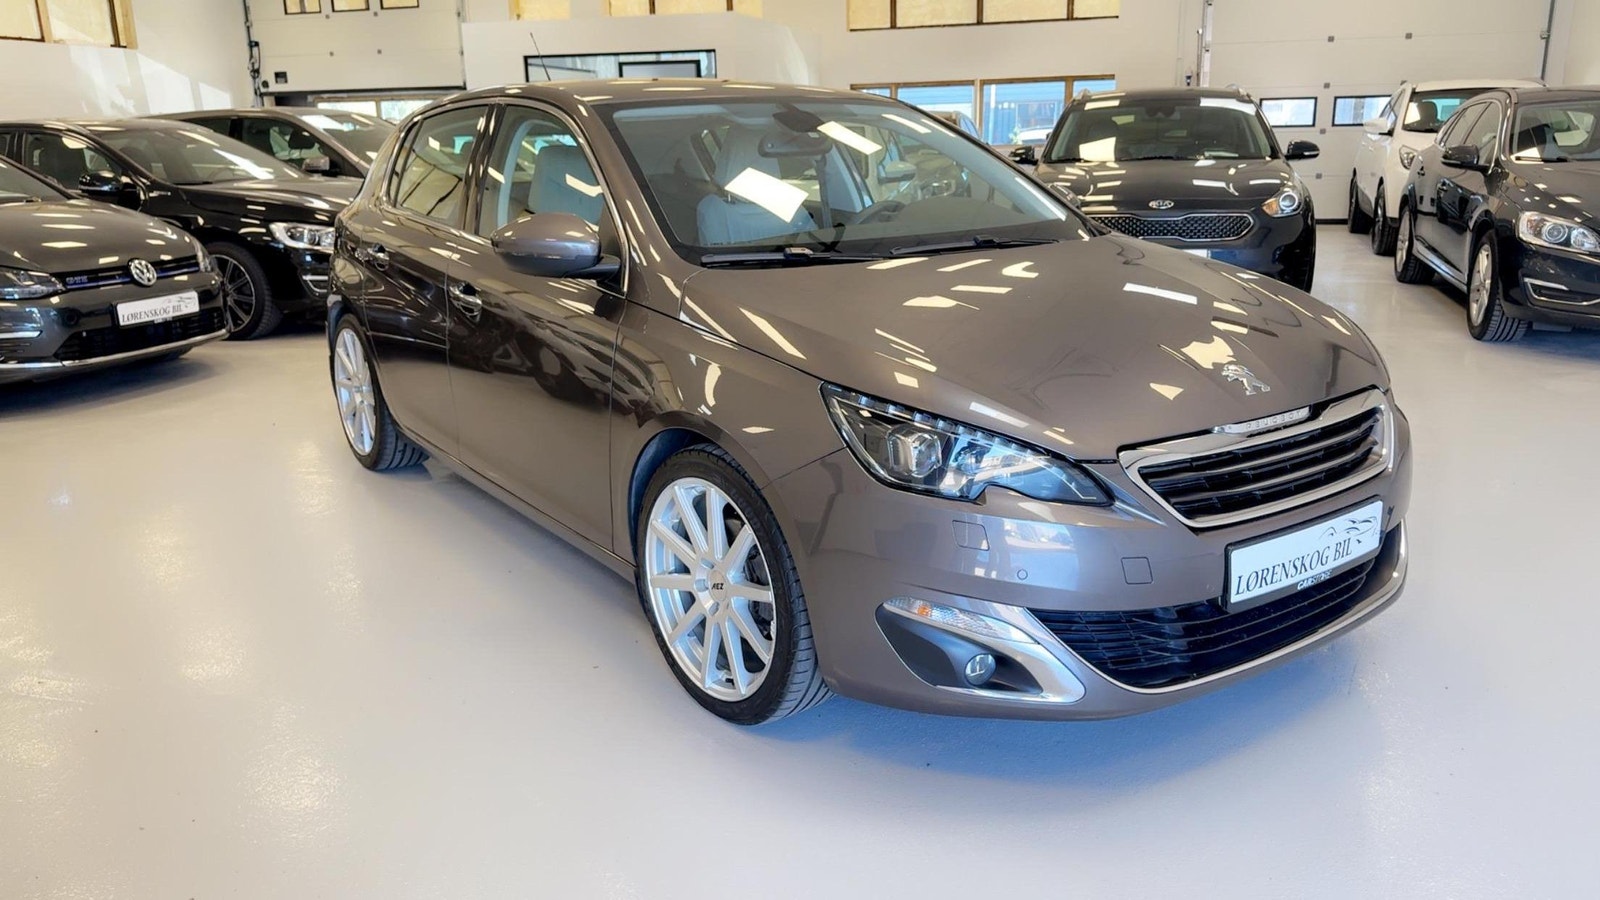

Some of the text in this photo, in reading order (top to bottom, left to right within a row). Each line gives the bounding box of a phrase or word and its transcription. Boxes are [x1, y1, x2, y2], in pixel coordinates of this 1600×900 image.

[1148, 200, 1174, 210] KIA
[122, 306, 171, 323] LØRENSKOG
[172, 304, 183, 315] BIL
[1246, 410, 1302, 429] PEUGEOT
[1234, 537, 1353, 596] LØRENSKOG BIL
[711, 582, 725, 590] AEZ
